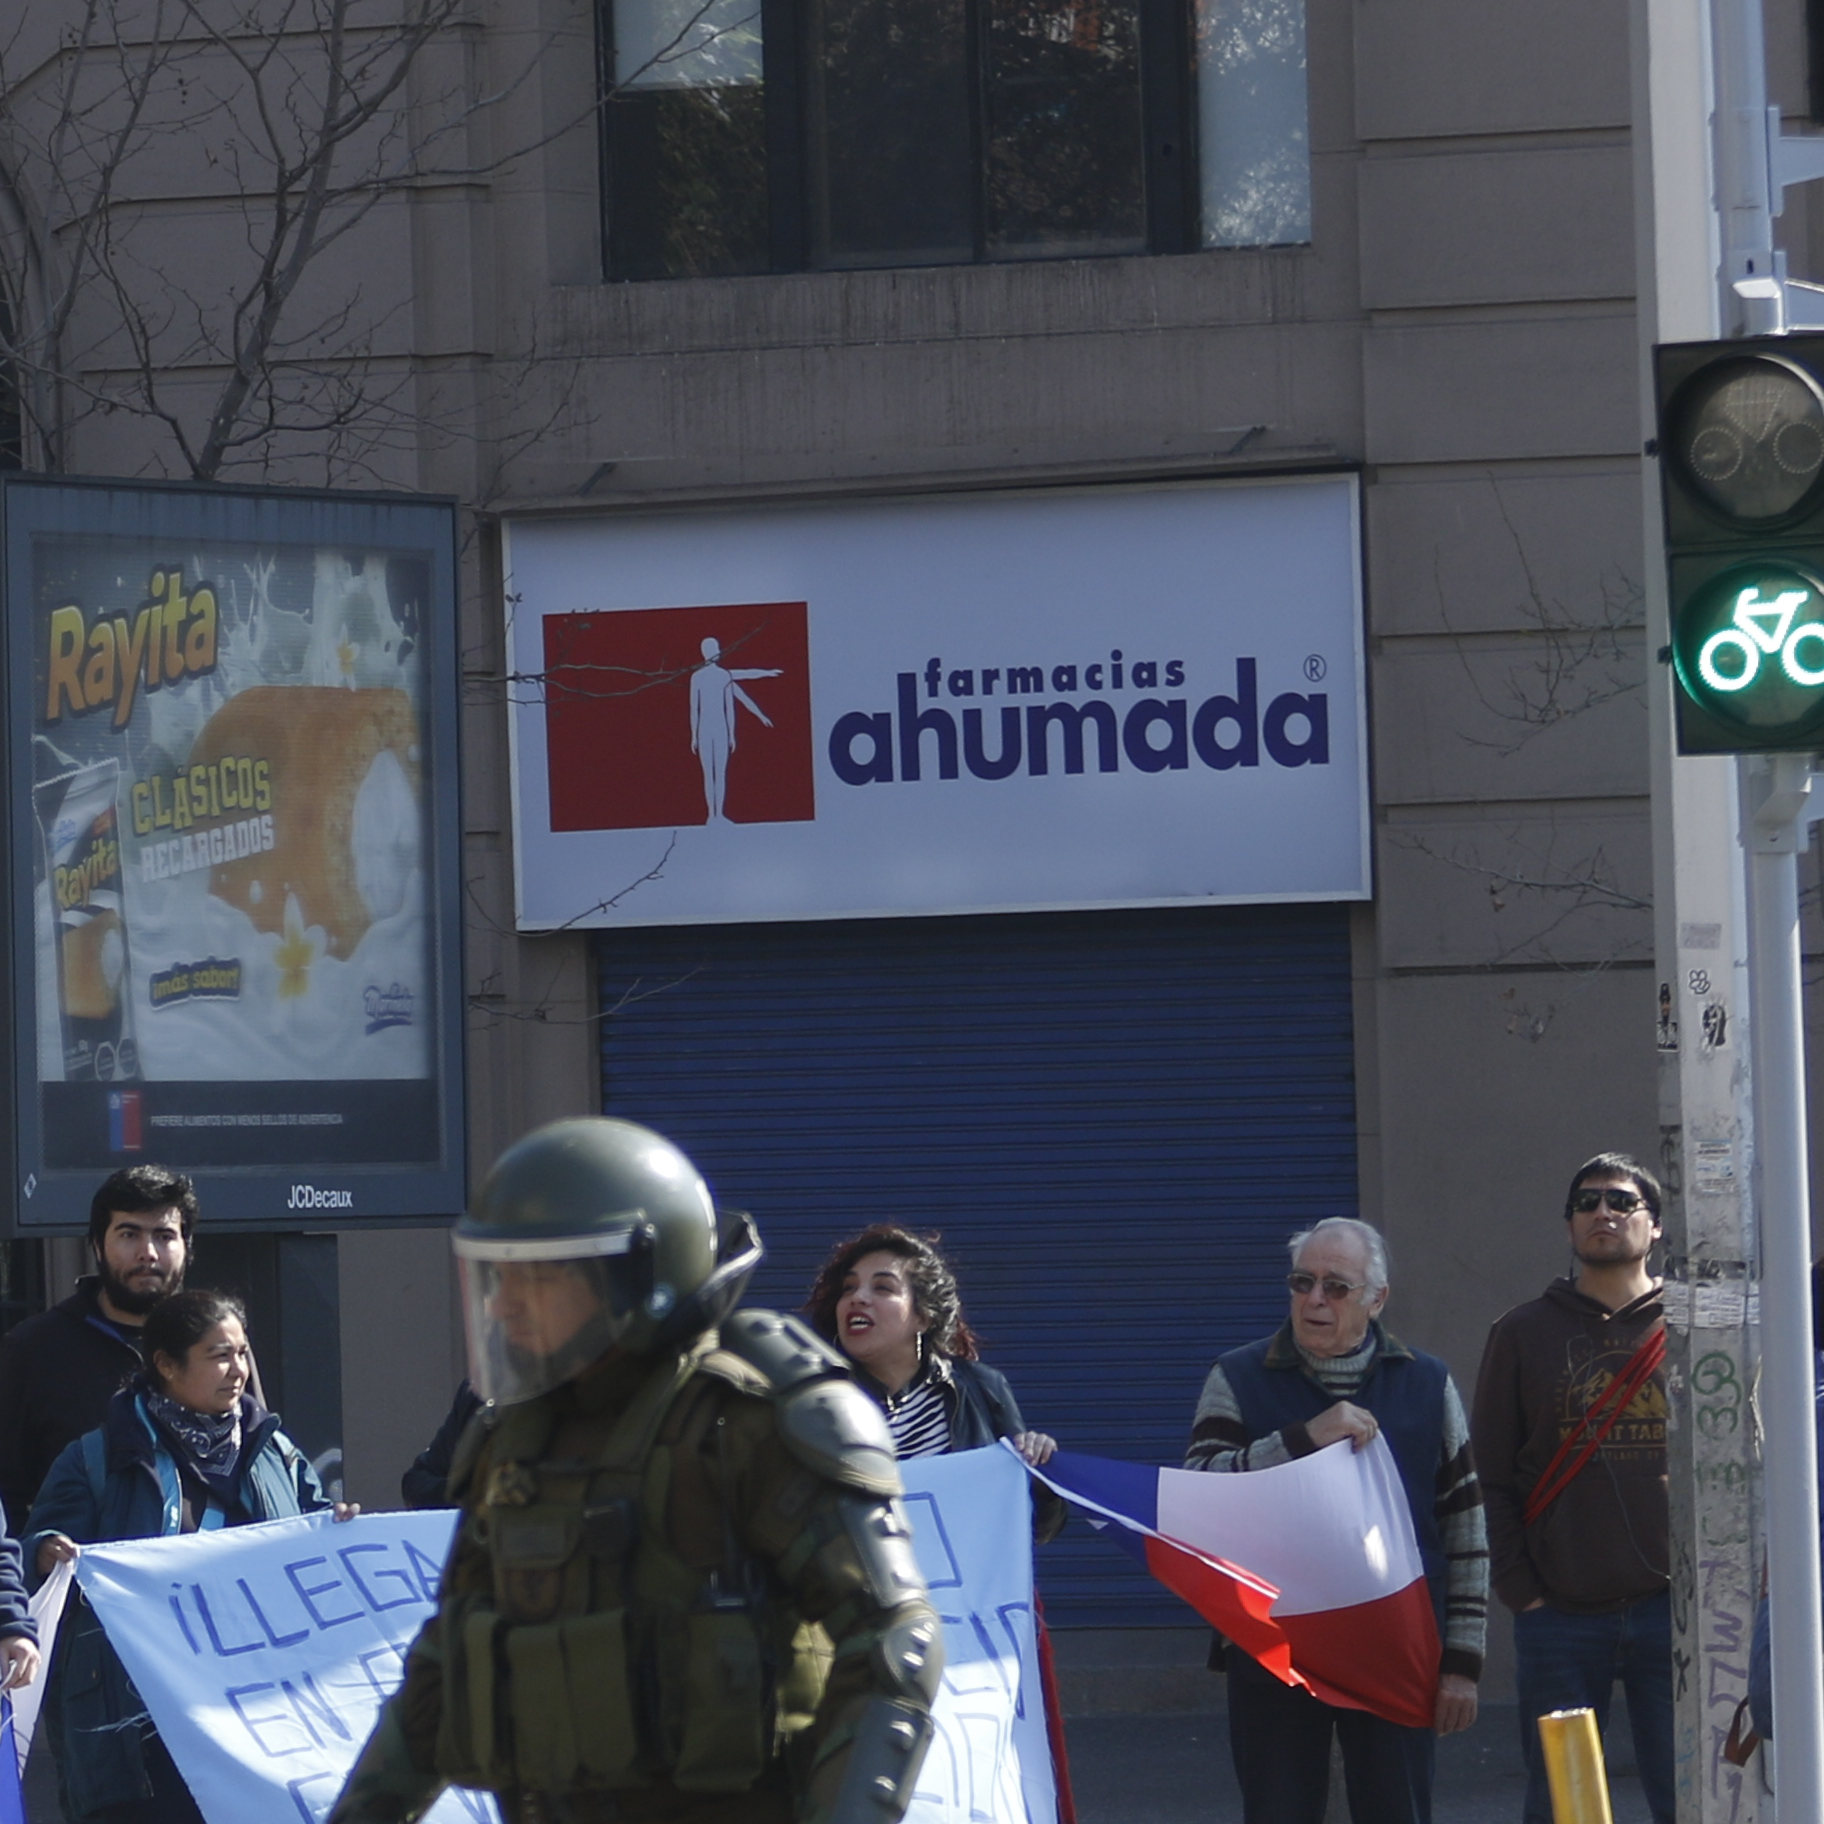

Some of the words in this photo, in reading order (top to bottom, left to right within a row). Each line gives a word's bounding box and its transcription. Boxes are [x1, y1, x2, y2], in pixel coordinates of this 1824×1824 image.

[45, 569, 217, 729] Rayita
[924, 649, 1186, 698] farmacias
[828, 656, 1330, 786] ahumada
[132, 755, 272, 835] CLÁSICOS
[140, 813, 275, 884] RECARGADOS
[287, 1184, 353, 1209] JCDecaux
